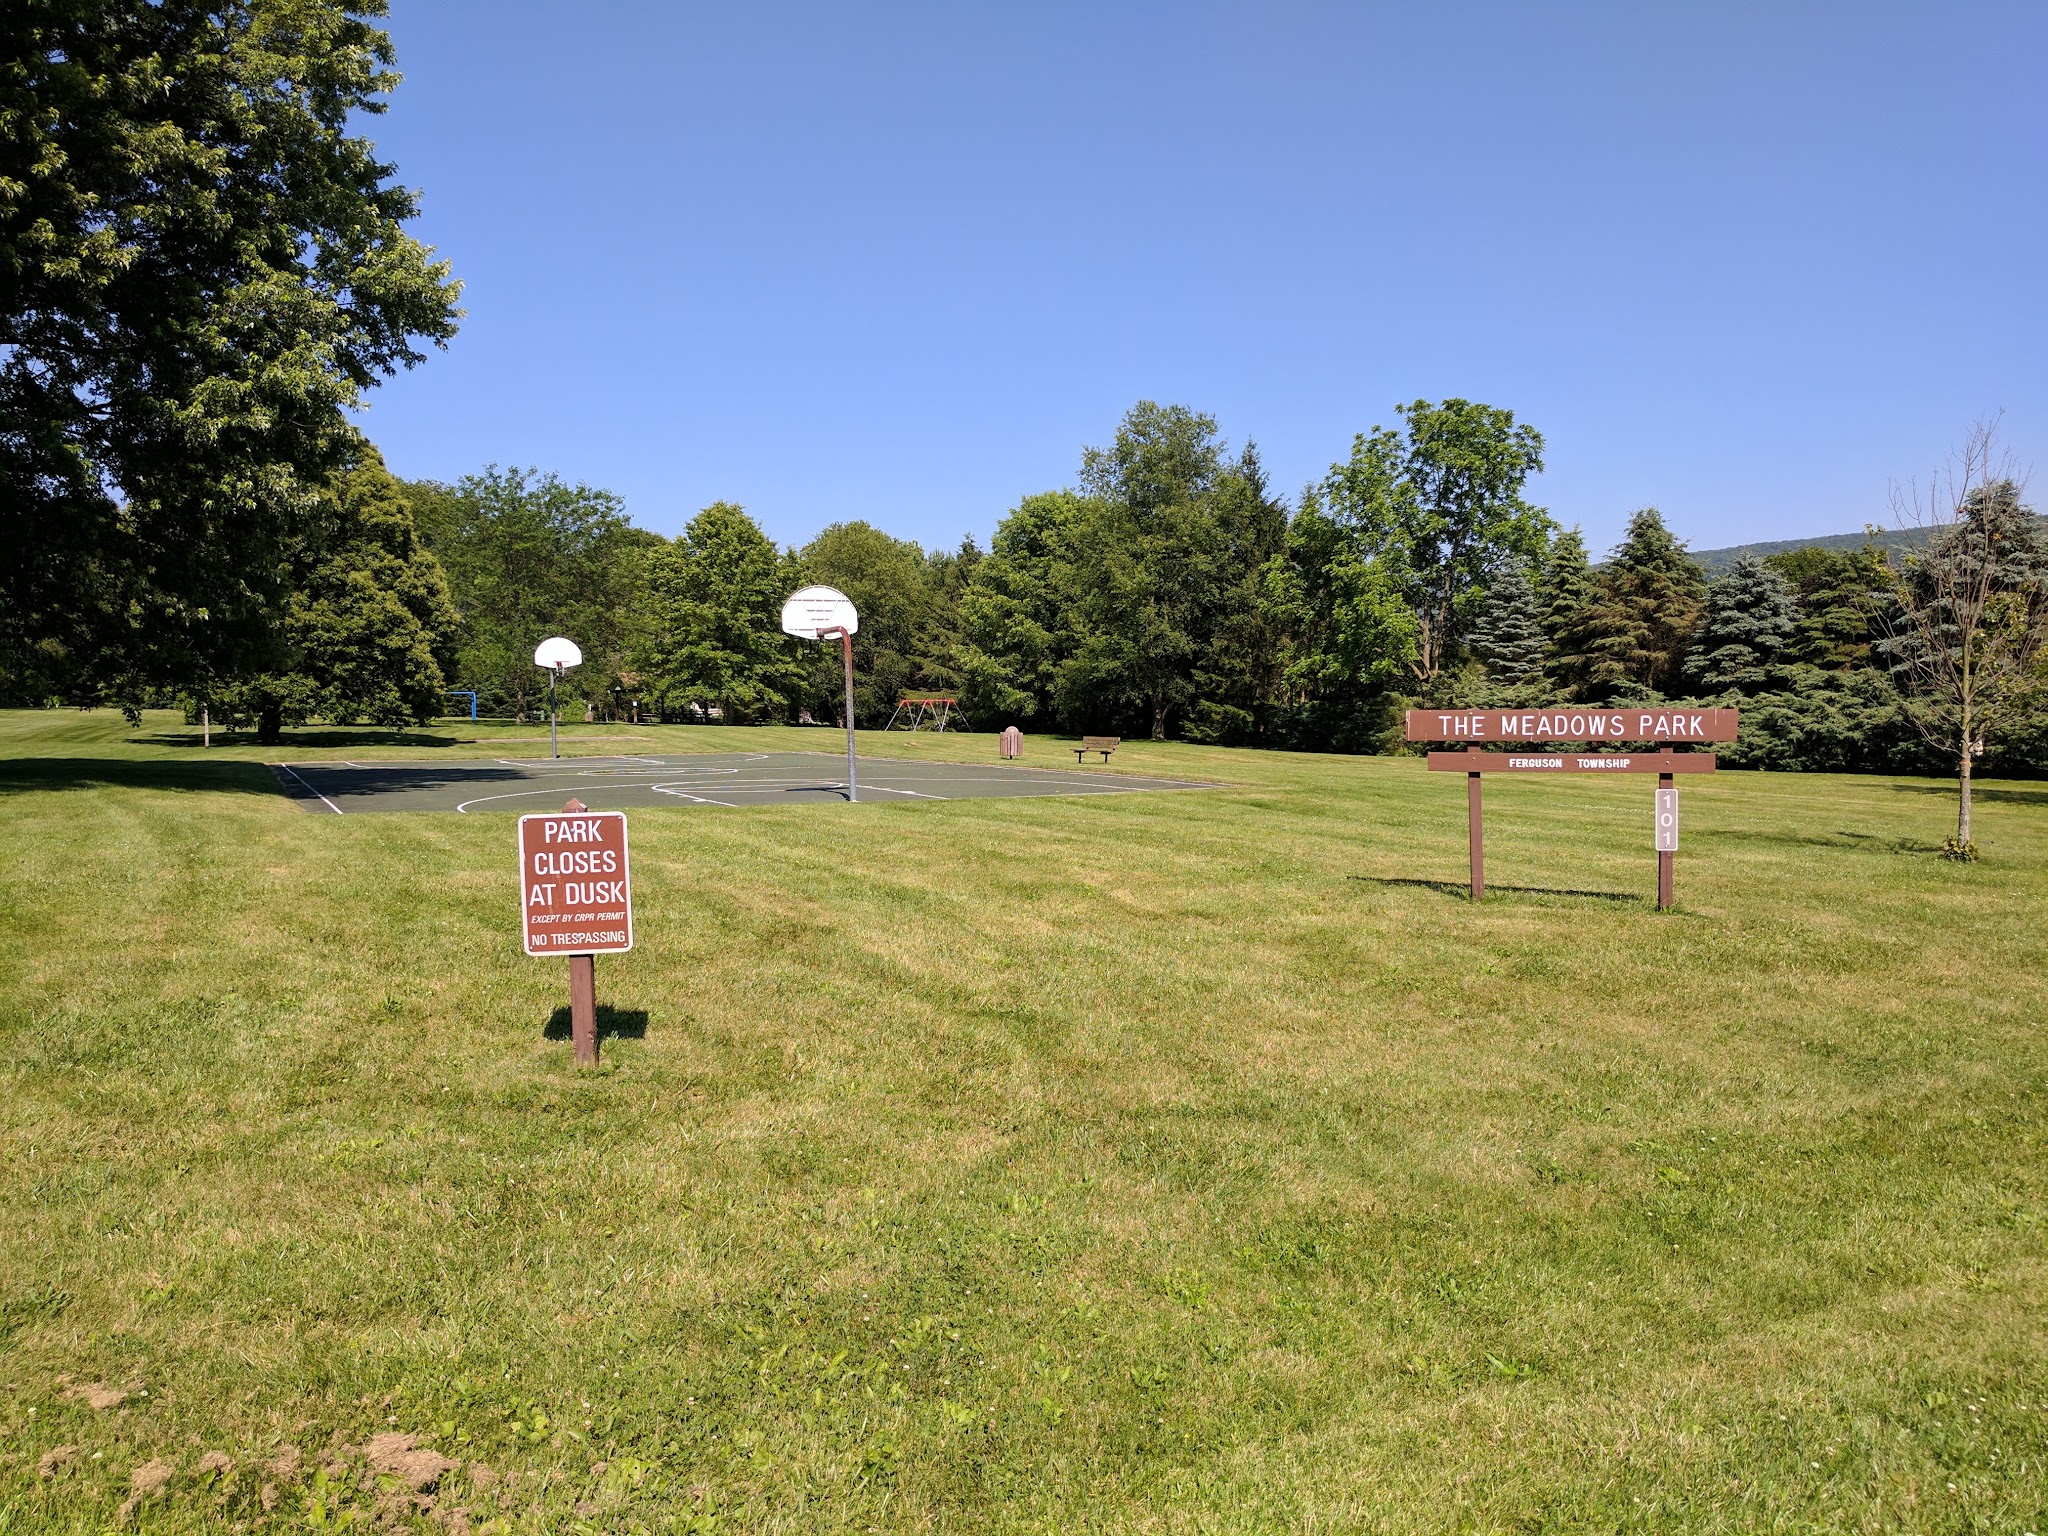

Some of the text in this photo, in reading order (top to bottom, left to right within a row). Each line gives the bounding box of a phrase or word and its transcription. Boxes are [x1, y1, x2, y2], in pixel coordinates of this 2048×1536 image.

[1438, 715, 1704, 736] THE MEADOWS PARK
[1509, 758, 1630, 768] FERGUSON TOWNSHIP
[1660, 794, 1673, 846] 101
[544, 820, 603, 843] PARK
[534, 850, 617, 875] CLOSES
[529, 881, 625, 906] AT DUSK
[531, 912, 625, 923] EXCEPT BY CRPR PERMIT
[531, 931, 625, 946] NO TRESPASSING
